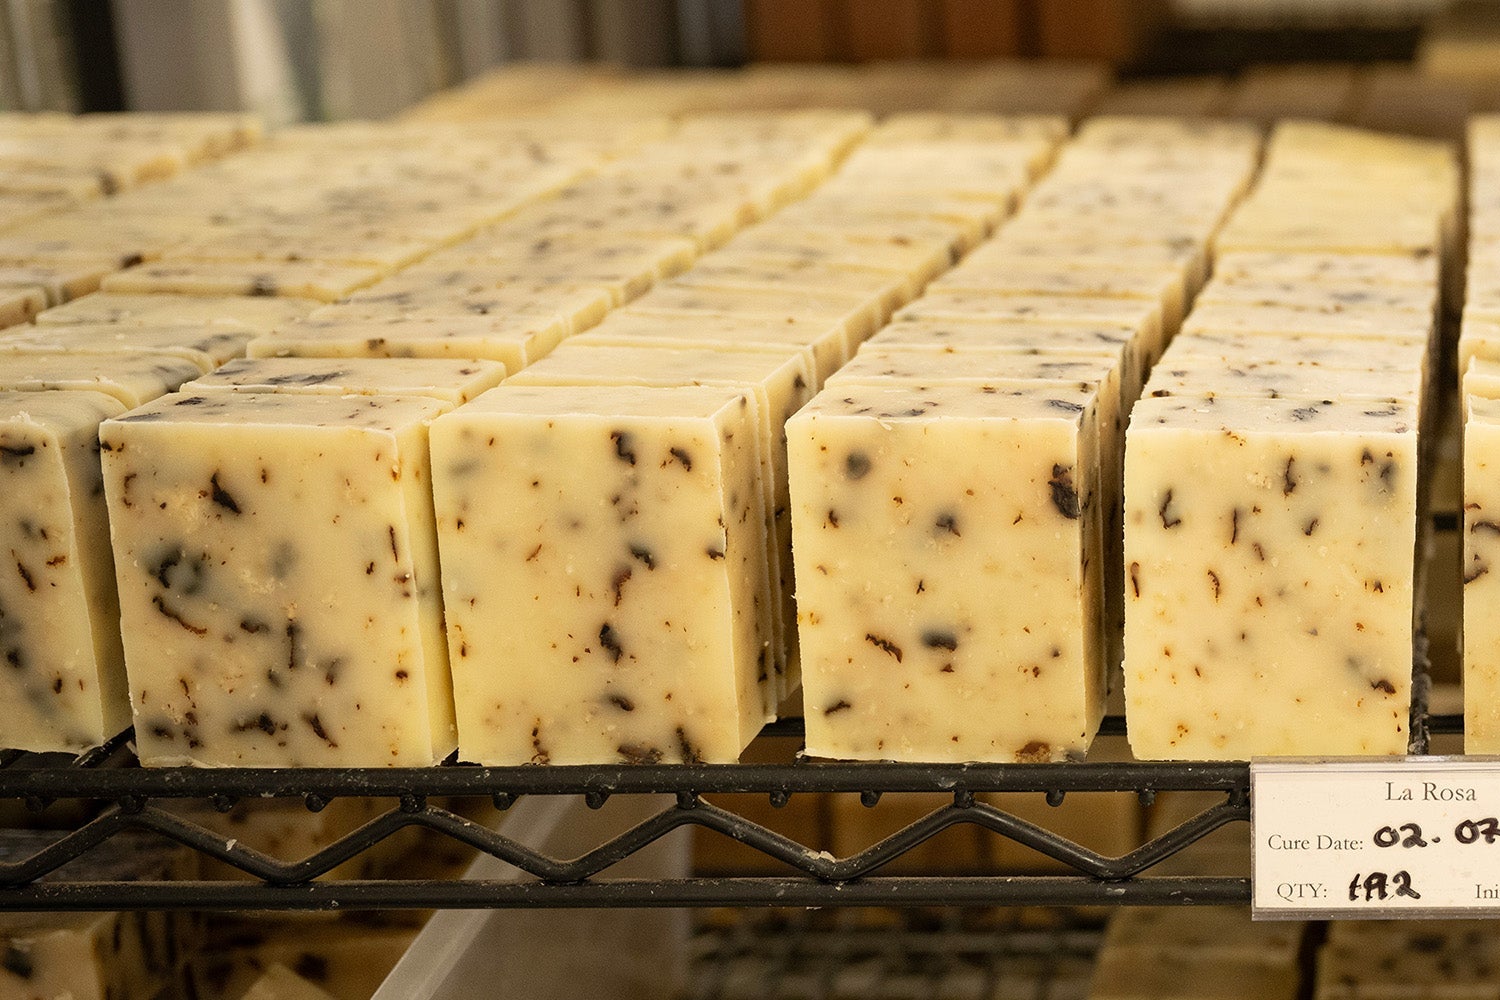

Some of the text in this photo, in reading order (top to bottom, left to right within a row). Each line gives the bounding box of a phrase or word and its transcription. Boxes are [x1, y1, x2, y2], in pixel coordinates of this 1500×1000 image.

[1385, 782, 1477, 801] La Rosa
[1268, 835, 1311, 850] Cure
[1317, 835, 1363, 850] Date:
[1277, 883, 1327, 901] QTY:
